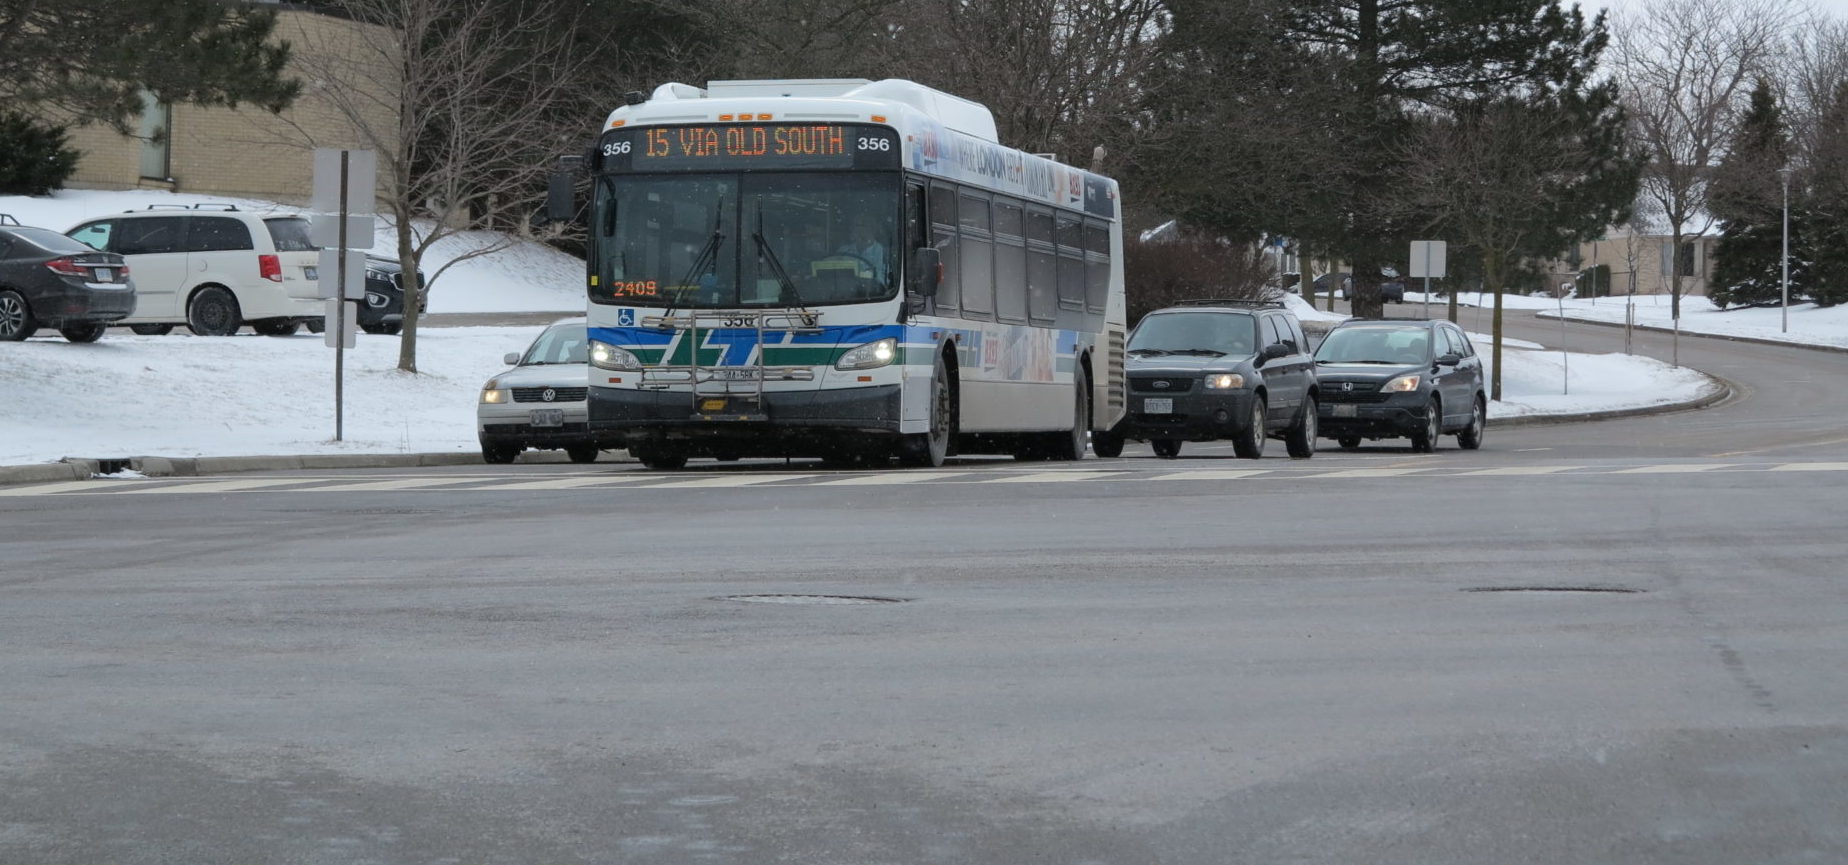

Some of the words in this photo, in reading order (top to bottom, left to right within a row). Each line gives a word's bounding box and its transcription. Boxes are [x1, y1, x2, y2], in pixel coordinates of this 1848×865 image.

[603, 141, 631, 157] 356
[646, 129, 669, 157] 15
[679, 128, 719, 156] VIA
[726, 127, 766, 156] OLD
[774, 126, 844, 155] SOUTH
[857, 137, 890, 151] 356
[976, 142, 1006, 180] LONDON
[613, 281, 656, 297] 2409
